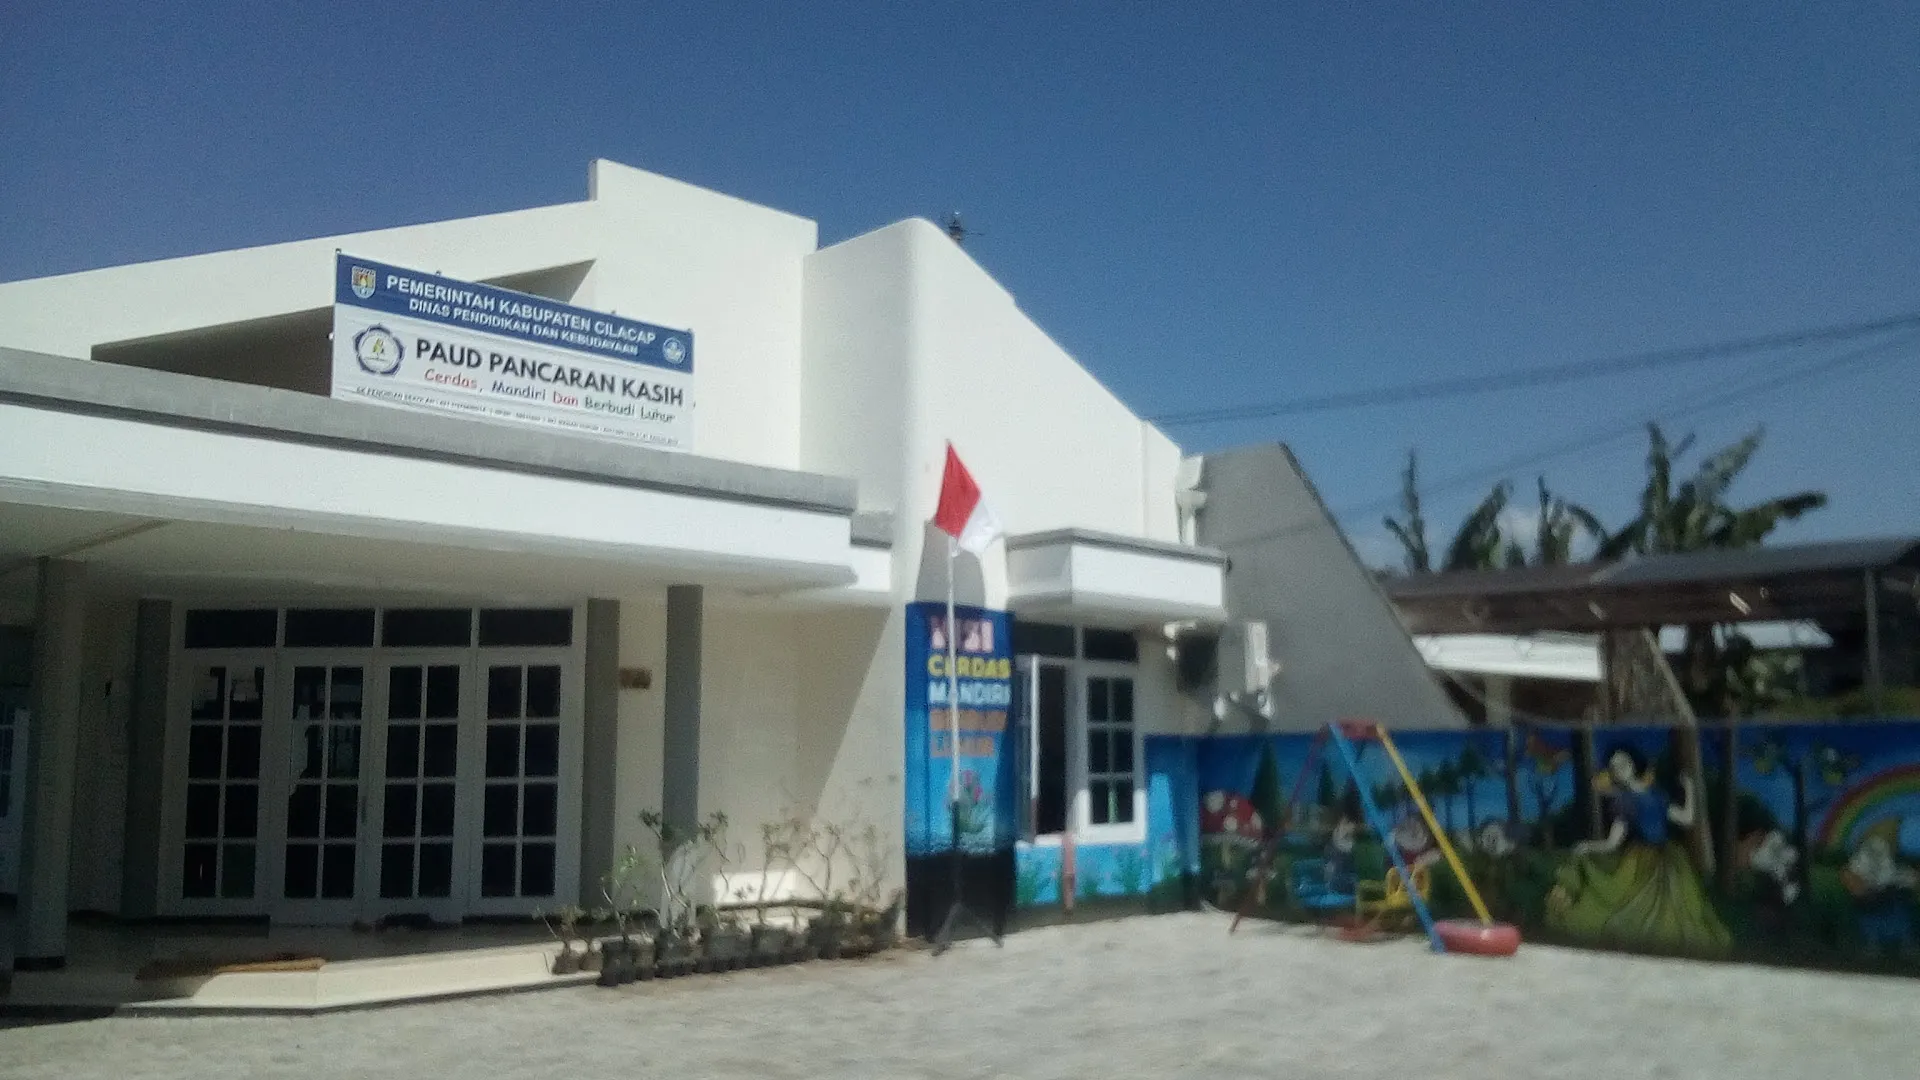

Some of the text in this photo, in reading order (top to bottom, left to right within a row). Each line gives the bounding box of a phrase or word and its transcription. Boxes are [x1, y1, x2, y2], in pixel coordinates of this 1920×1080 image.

[386, 274, 656, 345] PEMERINTAH KABUPATEN CILACAP
[409, 299, 639, 356] DINAS PENDIDIKAN DAN KEBUDAYAAN
[415, 338, 684, 408] PAUD PANCARAN KASIH
[491, 379, 546, 402] Mandiri
[552, 391, 579, 407] Dan
[584, 396, 636, 417] Berbudi
[641, 407, 677, 424] Luhur
